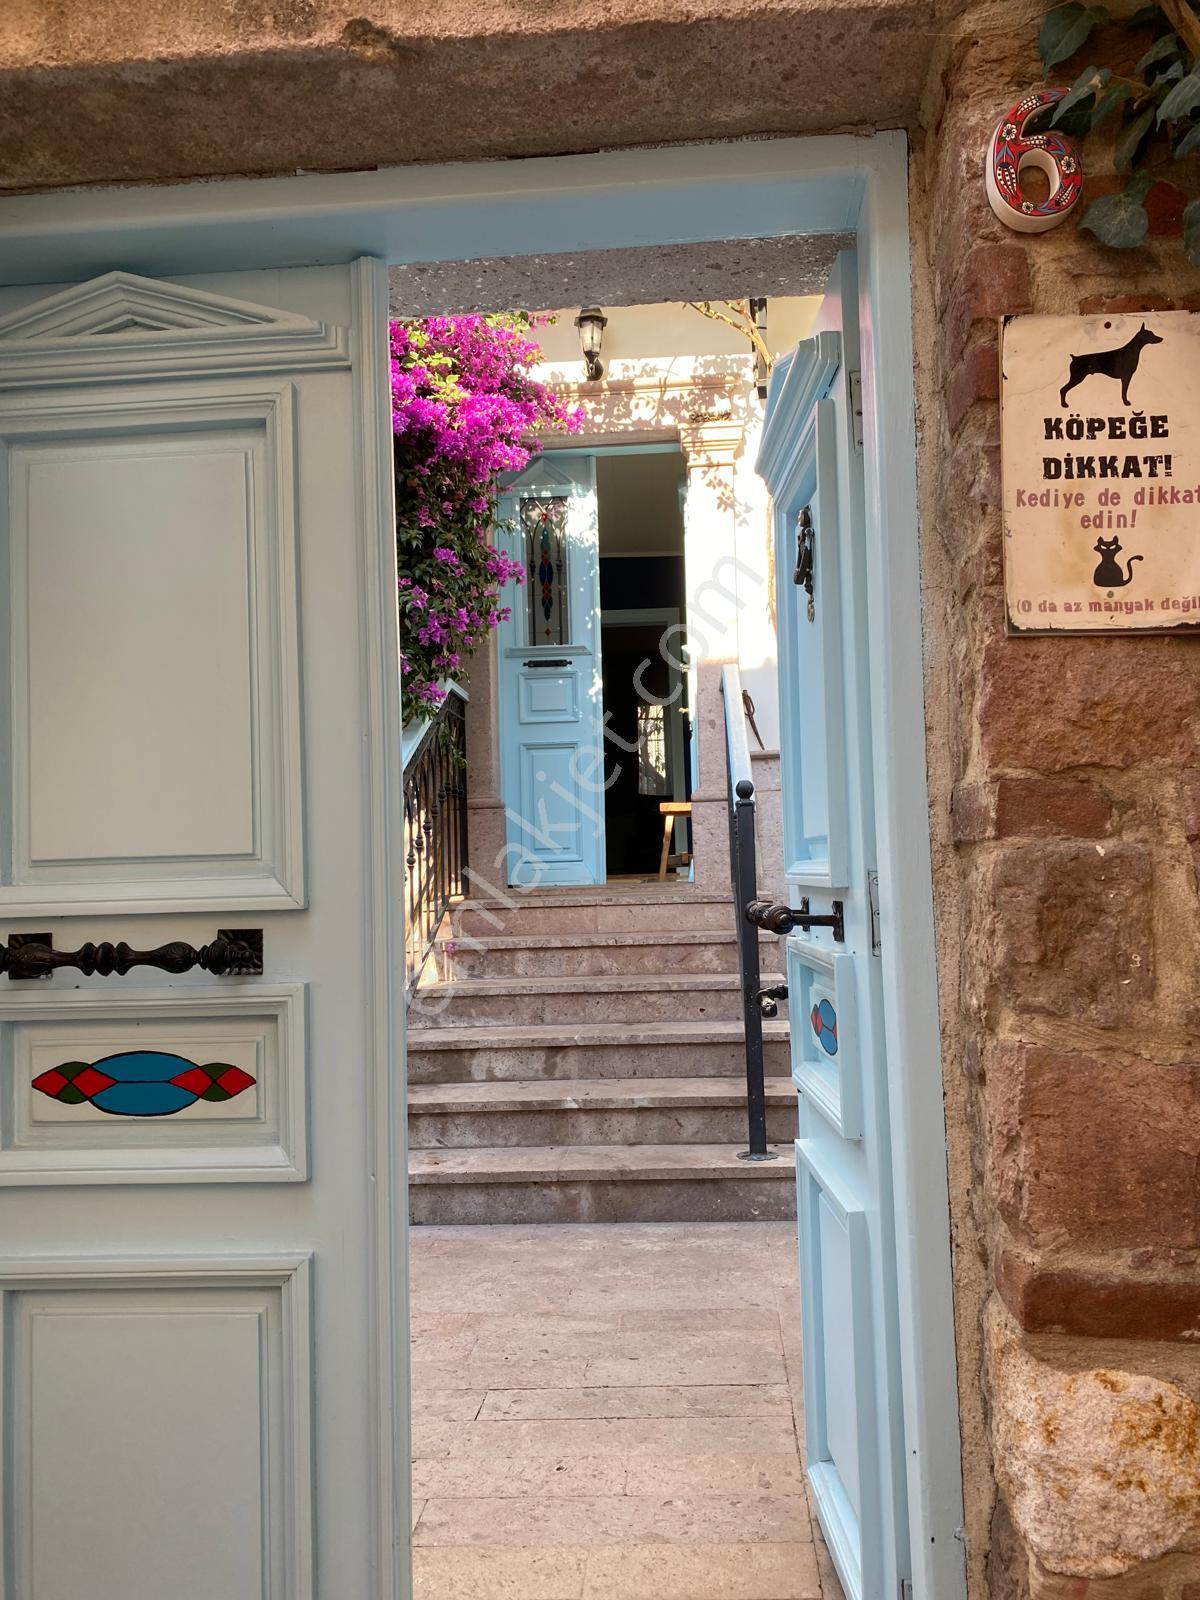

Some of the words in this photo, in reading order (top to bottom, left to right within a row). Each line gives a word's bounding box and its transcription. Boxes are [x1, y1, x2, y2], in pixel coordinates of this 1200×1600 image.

[986, 87, 1083, 233] 6
[1043, 410, 1169, 441] KÖPEĞE
[1042, 452, 1173, 480] DİKKAT!
[1016, 488, 1086, 509] Kediye
[1097, 487, 1121, 506] de
[1133, 485, 1200, 506] dikkat
[1080, 509, 1137, 529] edin!
[1038, 599, 1057, 613] da
[1063, 601, 1083, 613] az
[1088, 599, 1154, 615] manyak
